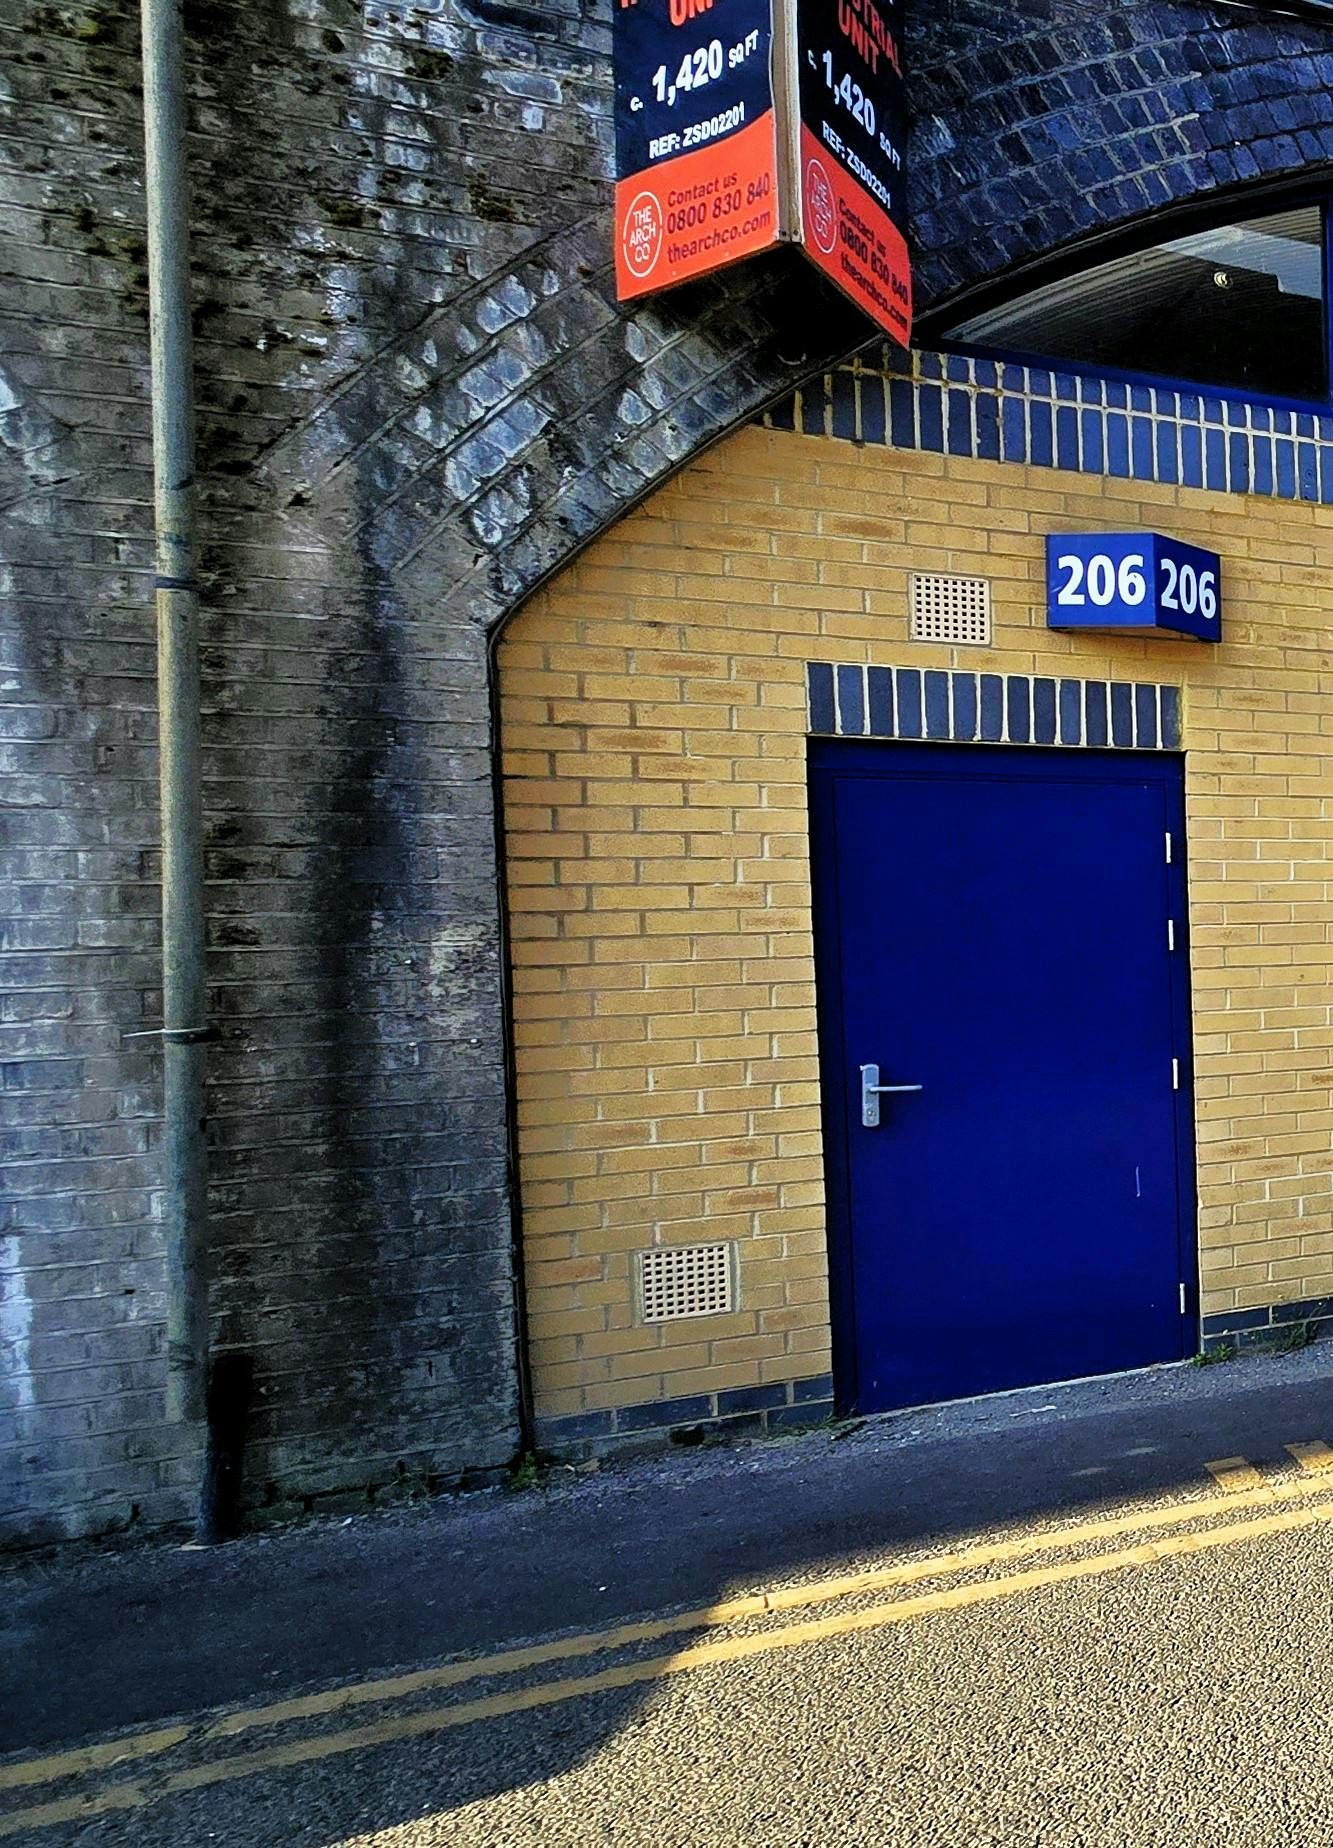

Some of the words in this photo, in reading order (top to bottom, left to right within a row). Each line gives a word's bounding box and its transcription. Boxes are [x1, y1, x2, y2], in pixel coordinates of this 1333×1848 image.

[652, 39, 723, 106] 1,420
[728, 43, 744, 69] SQ
[745, 29, 759, 56] FT
[822, 49, 876, 136] 1,420
[650, 133, 681, 159] REF:
[682, 101, 745, 147] ZSD02201
[633, 205, 652, 227] THE
[667, 202, 707, 234] 0800
[712, 189, 742, 219] 830
[746, 171, 770, 206] 840
[668, 177, 720, 208] Contact
[723, 172, 738, 190] us
[629, 222, 656, 247] ARCH
[634, 244, 651, 263] CO
[668, 210, 771, 264] thearchco.com
[840, 220, 868, 264] 0800
[1058, 554, 1146, 606] 206
[1160, 558, 1217, 620] 206
